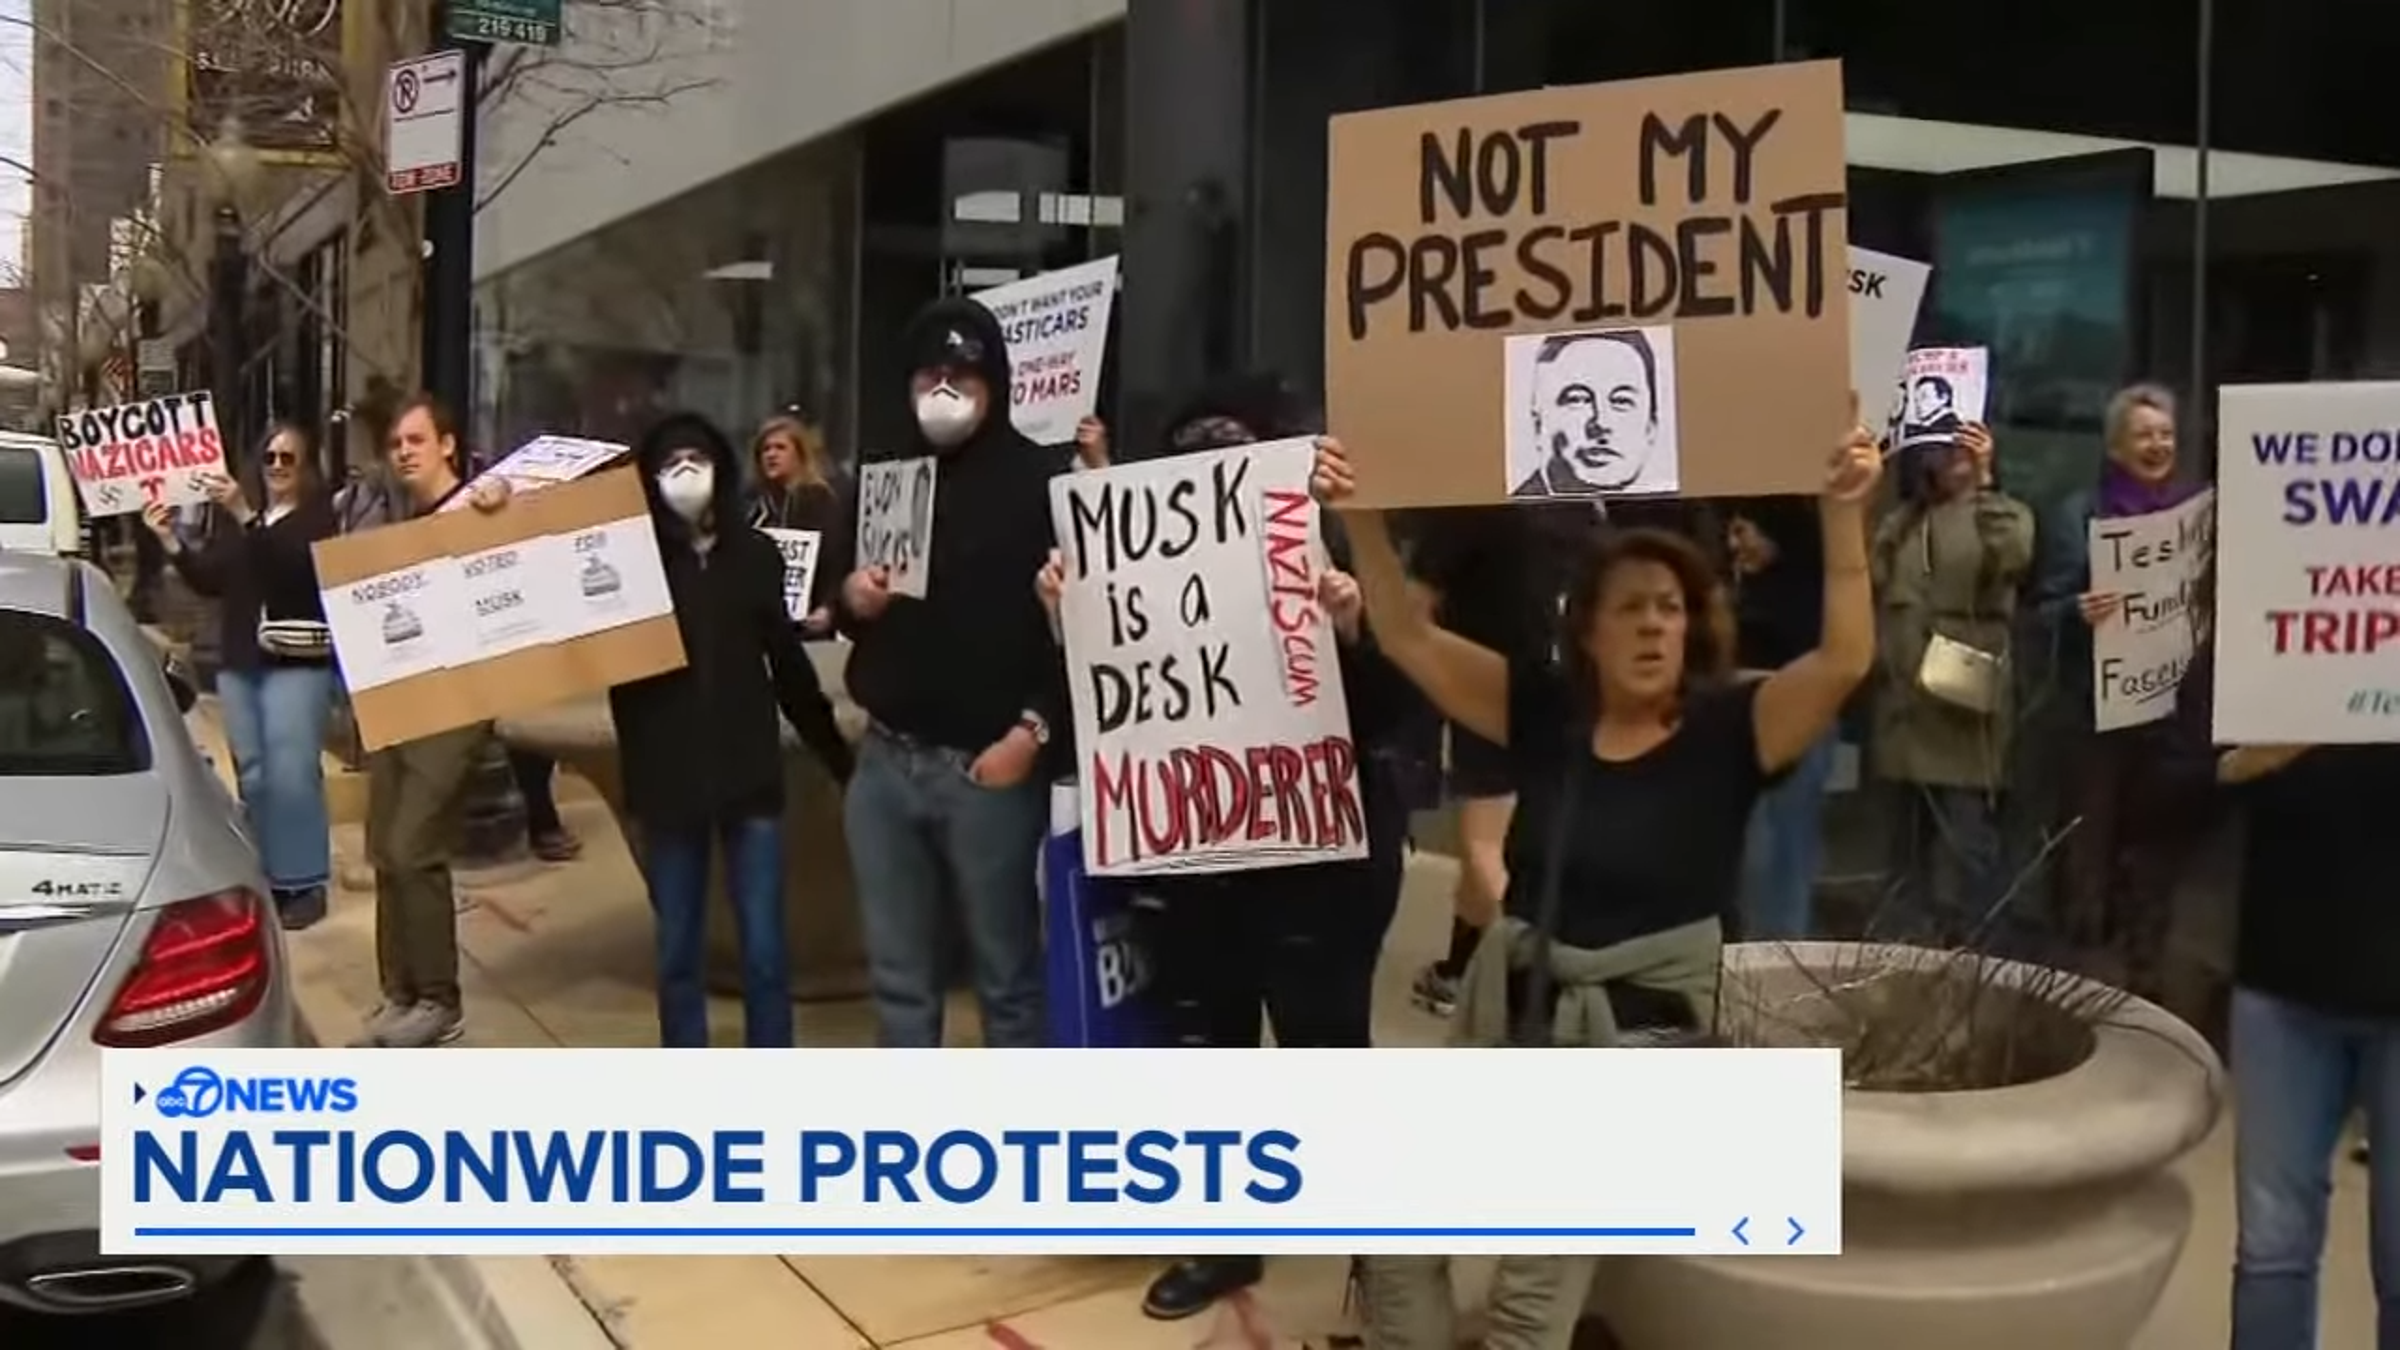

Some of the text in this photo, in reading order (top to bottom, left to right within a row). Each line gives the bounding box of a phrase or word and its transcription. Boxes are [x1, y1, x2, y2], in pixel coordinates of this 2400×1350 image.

[1420, 108, 1782, 224] NOT MY
[1346, 192, 1845, 340] PRESIDENT
[1847, 269, 1886, 299] SK
[1029, 370, 1081, 403] MARS
[59, 393, 208, 449] BOYCOTT
[2253, 430, 2400, 464] WE DO
[73, 427, 220, 482] NAZICARS
[1068, 457, 1250, 580] MUSK
[352, 571, 424, 604] NOBODY
[475, 590, 525, 617] MUSK
[2305, 564, 2400, 597] TAKE
[1106, 573, 1210, 647] is a
[2265, 609, 2400, 655] TRIP
[1090, 642, 1241, 735] DESK
[1092, 735, 1362, 867] MURDERER
